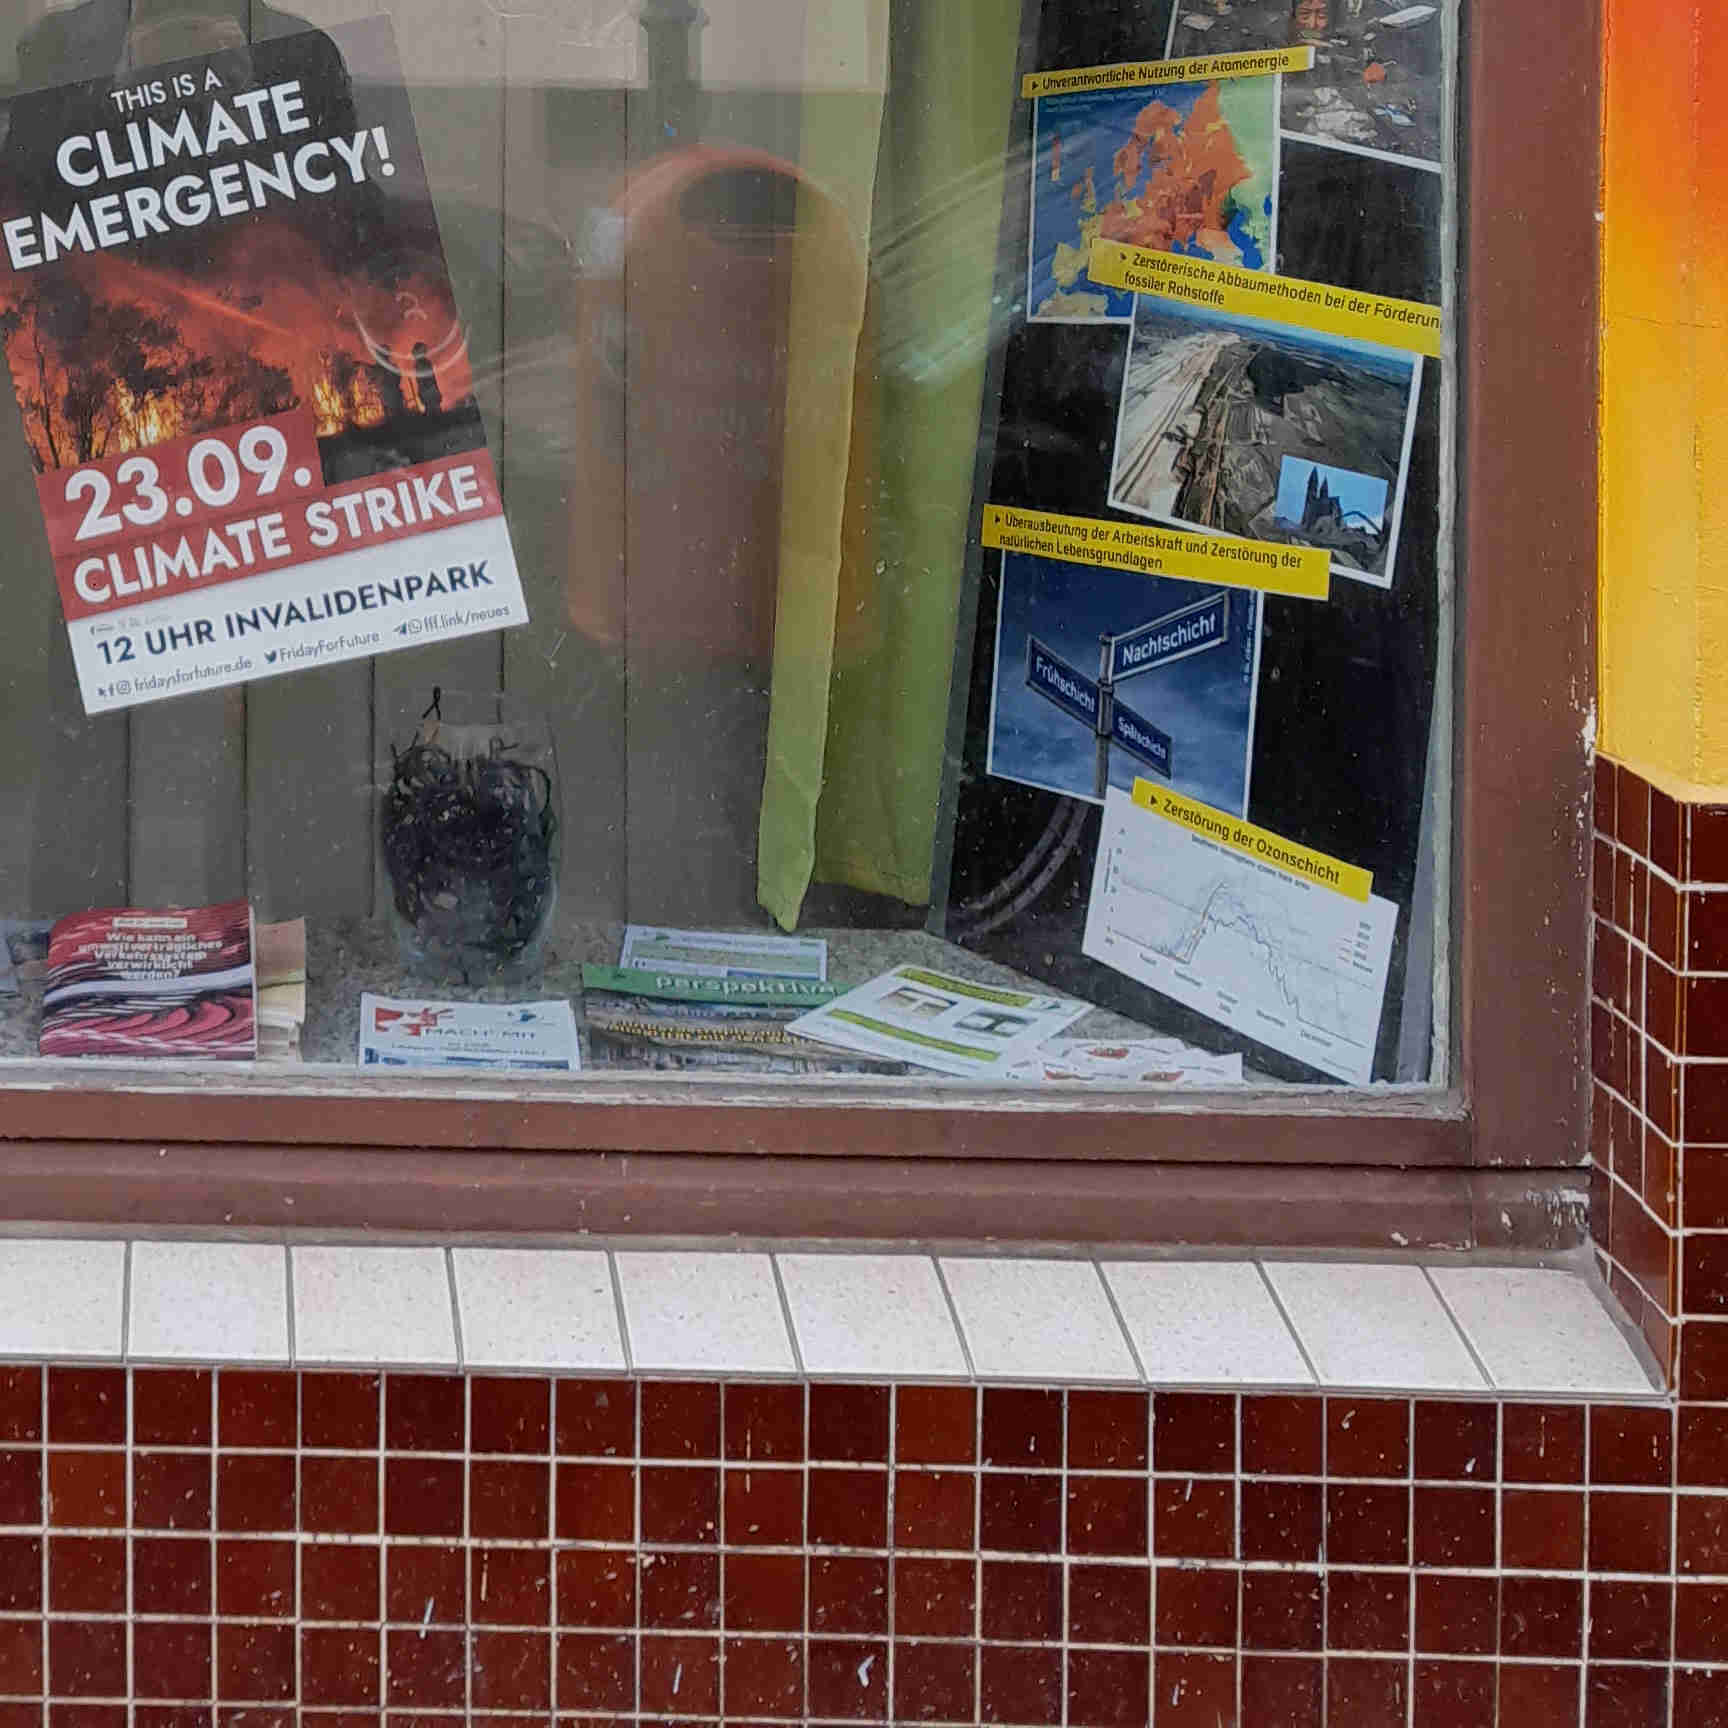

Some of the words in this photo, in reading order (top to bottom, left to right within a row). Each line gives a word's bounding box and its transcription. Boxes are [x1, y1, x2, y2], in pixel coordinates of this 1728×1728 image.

[111, 82, 167, 114] THIS
[172, 74, 195, 98] IS
[204, 67, 222, 91] A
[55, 79, 311, 187] CLIMATE
[2, 126, 397, 272] EMERGENCY!
[1218, 271, 1321, 306] Abbaumethoden
[1324, 291, 1346, 310] bei
[1347, 298, 1372, 317] der
[1373, 302, 1440, 329] Förderun
[65, 425, 312, 542] 23.09.
[73, 512, 292, 603] CLIMATE
[306, 464, 484, 549] STRIKE
[1090, 525, 1110, 541] der
[1112, 530, 1183, 553] Arbeitskraft
[1185, 539, 1208, 555] und
[1210, 542, 1278, 568] Zerstörung
[1280, 552, 1303, 569] der
[96, 636, 137, 666] 12
[145, 617, 216, 657] UHR
[224, 559, 495, 640] INVALIDENPARK
[1121, 612, 1216, 667] Nachtschicht
[1035, 655, 1096, 713] Frühschicht
[1233, 828, 1255, 849] der
[1256, 839, 1341, 885] Ozonschicht
